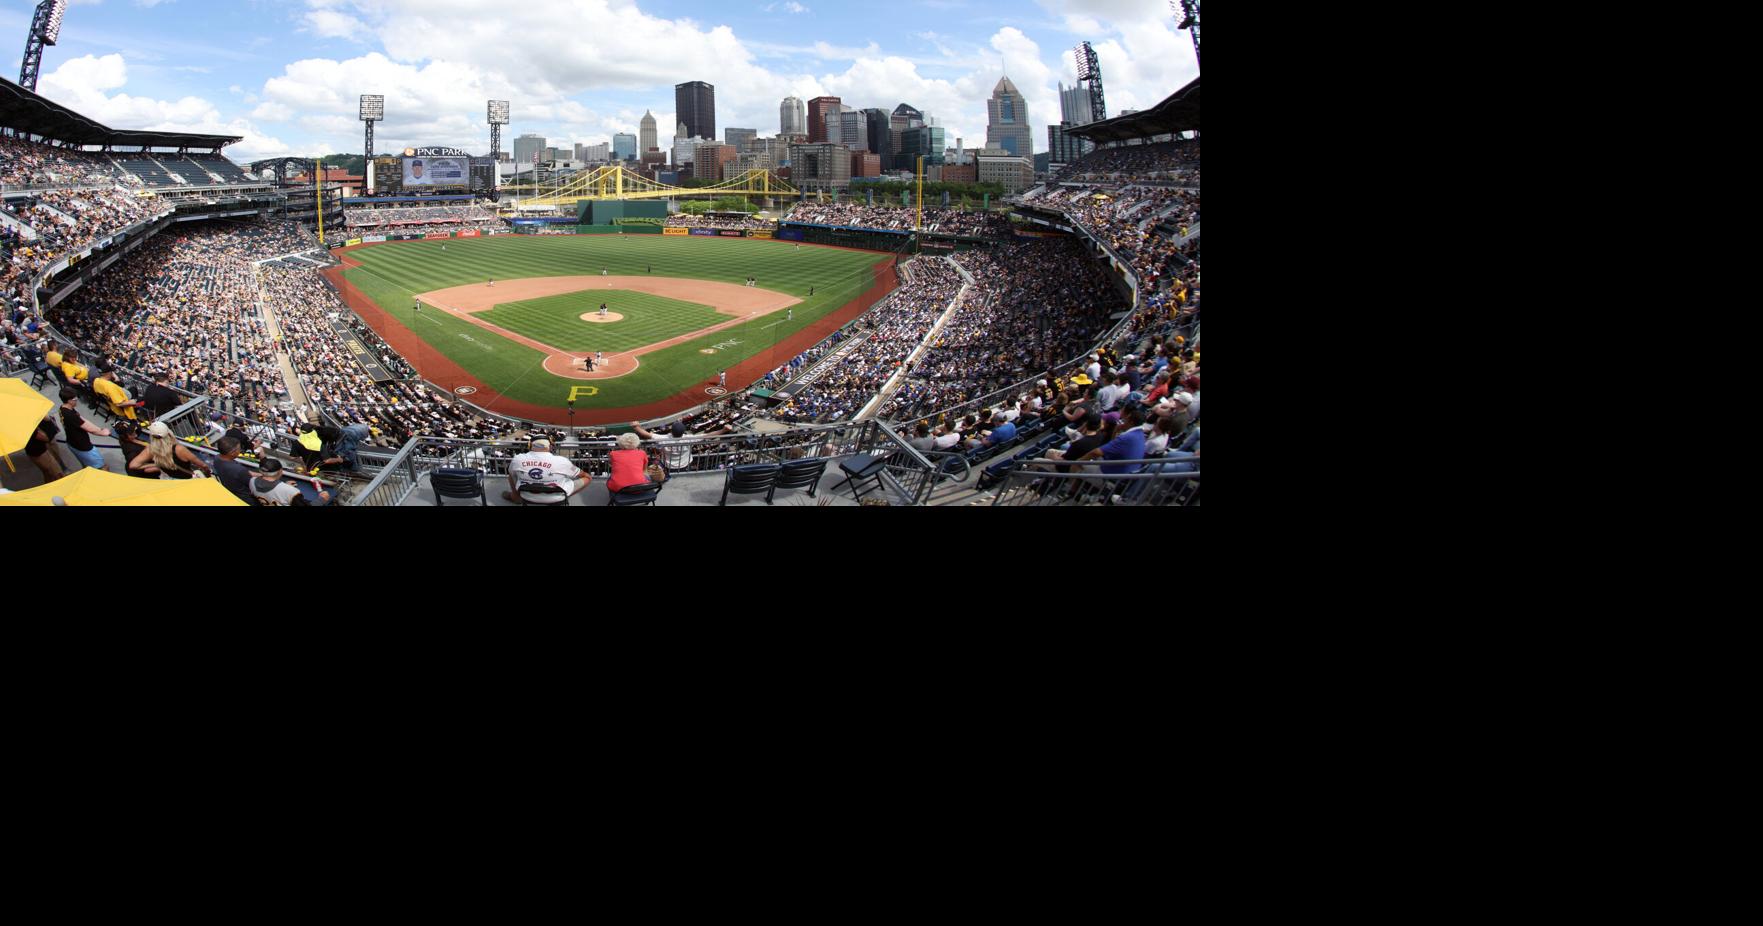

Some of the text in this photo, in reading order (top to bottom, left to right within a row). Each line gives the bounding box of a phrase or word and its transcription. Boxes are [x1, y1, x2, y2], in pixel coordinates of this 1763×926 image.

[417, 148, 467, 156] PNC PARK
[567, 385, 600, 401] P
[521, 460, 552, 469] CHICAGO
